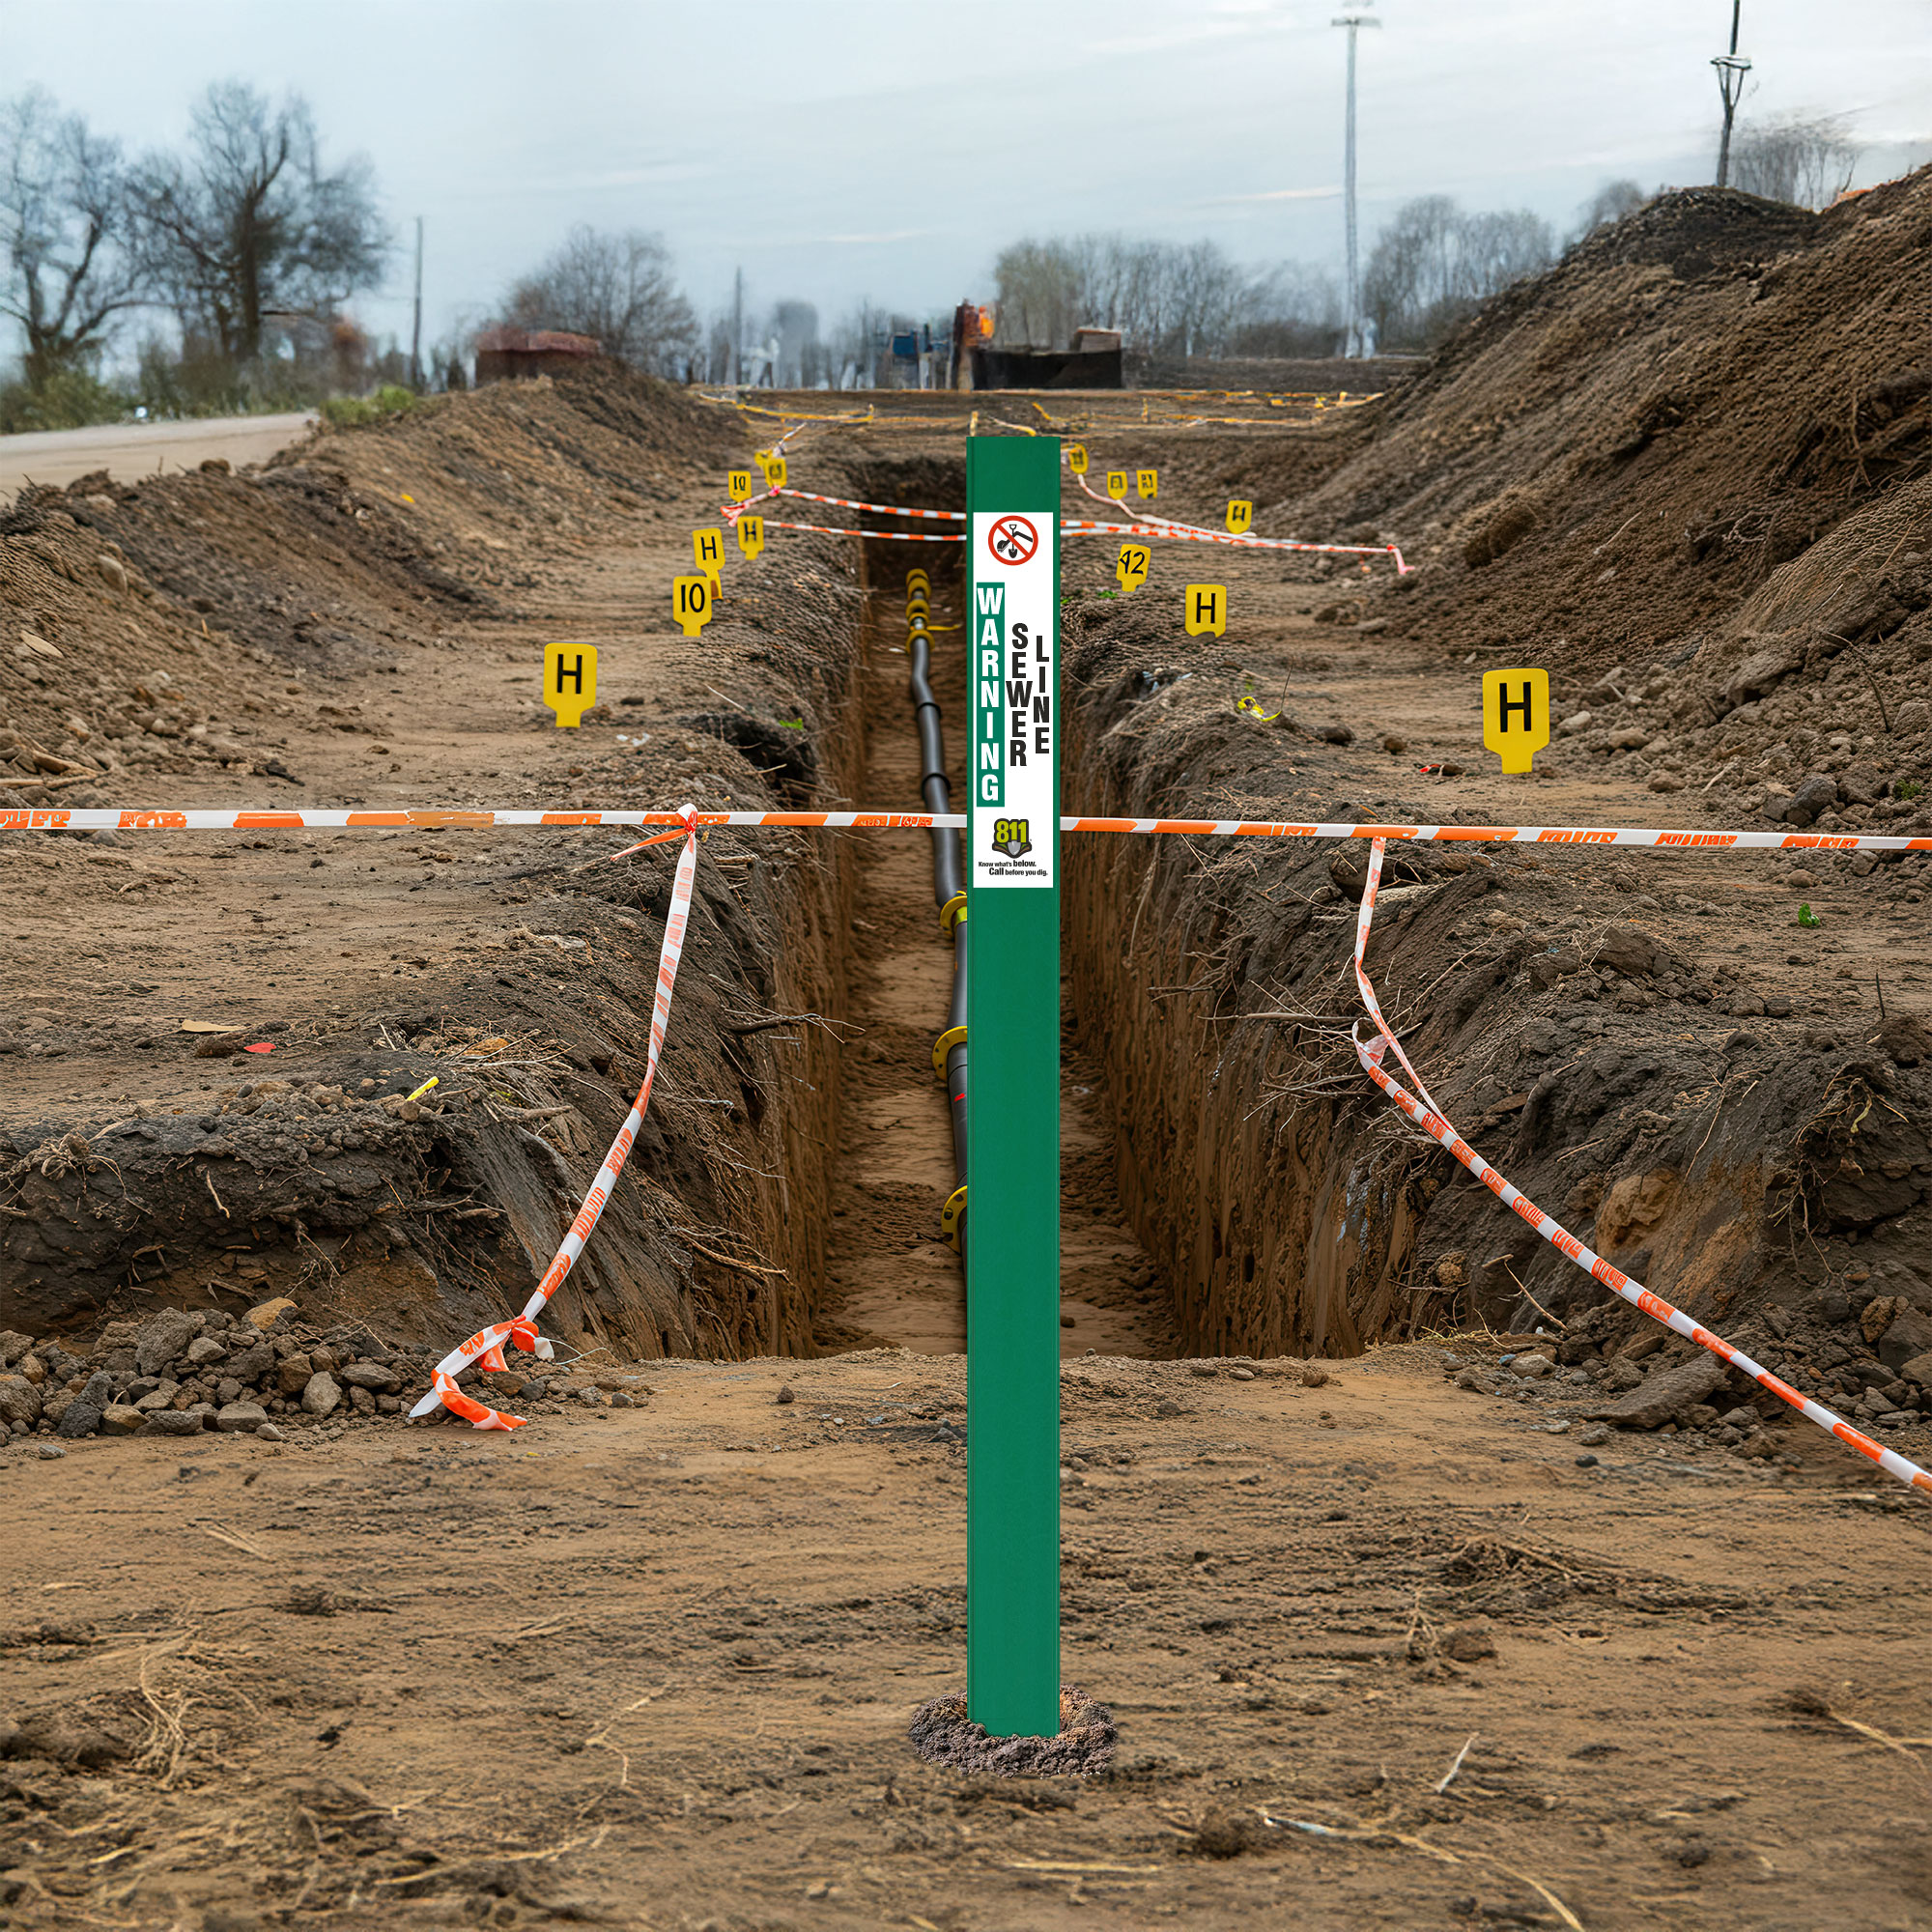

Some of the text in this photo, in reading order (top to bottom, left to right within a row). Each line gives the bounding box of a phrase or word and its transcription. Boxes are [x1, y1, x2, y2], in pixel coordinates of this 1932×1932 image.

[700, 535, 718, 561] H
[1196, 592, 1216, 624] H
[556, 653, 582, 695] H
[977, 587, 1004, 802] WARNING
[1006, 622, 1034, 767] SEWER
[1033, 635, 1050, 754] LINE
[1499, 681, 1532, 733] H
[996, 820, 1027, 843] 811
